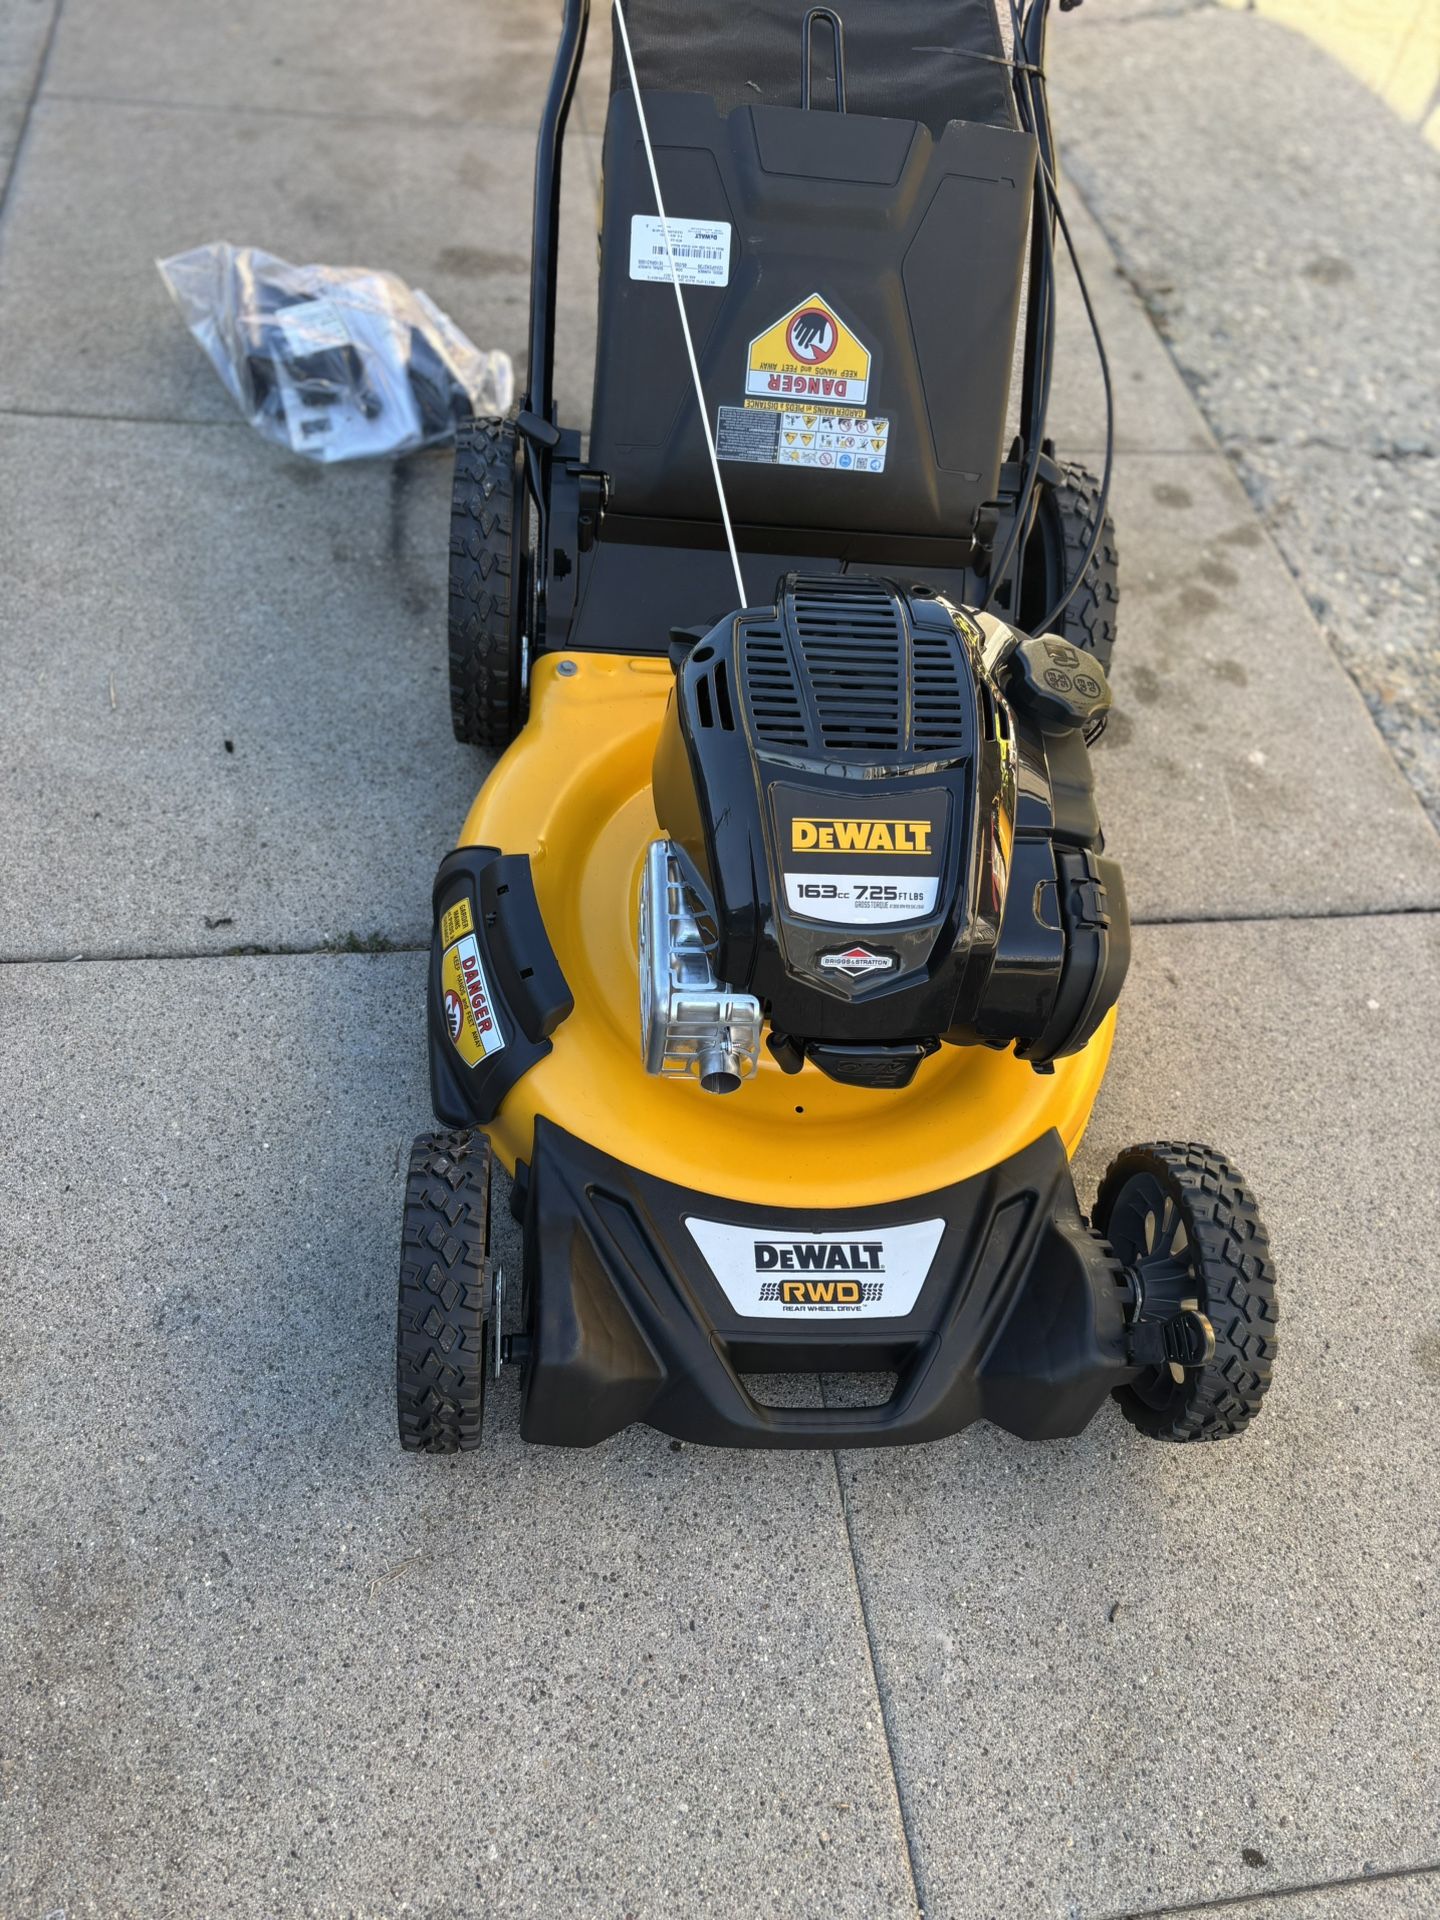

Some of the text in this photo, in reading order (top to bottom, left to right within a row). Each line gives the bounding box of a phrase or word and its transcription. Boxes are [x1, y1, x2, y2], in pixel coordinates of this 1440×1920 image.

[760, 362, 777, 371] AWAY
[781, 364, 797, 373] FEET
[815, 367, 838, 376] HANDS
[840, 370, 858, 378] KEEP
[767, 374, 848, 397] DANGER
[746, 400, 778, 411] DISTANCE
[785, 404, 805, 413] PIEDS
[814, 406, 835, 416] MAINS
[836, 407, 864, 418] GARDER
[792, 821, 931, 851] DEWALT
[853, 885, 897, 901] 7.25
[908, 892, 924, 901] LBS
[854, 901, 870, 909] GROSS
[460, 904, 469, 929] GARDER
[461, 955, 493, 1034] DANGER
[457, 974, 466, 996] HANDS
[466, 1010, 475, 1027] FEET
[472, 1031, 481, 1048] AWAY
[754, 1244, 883, 1270] DEWALT
[783, 1282, 860, 1302] RWD
